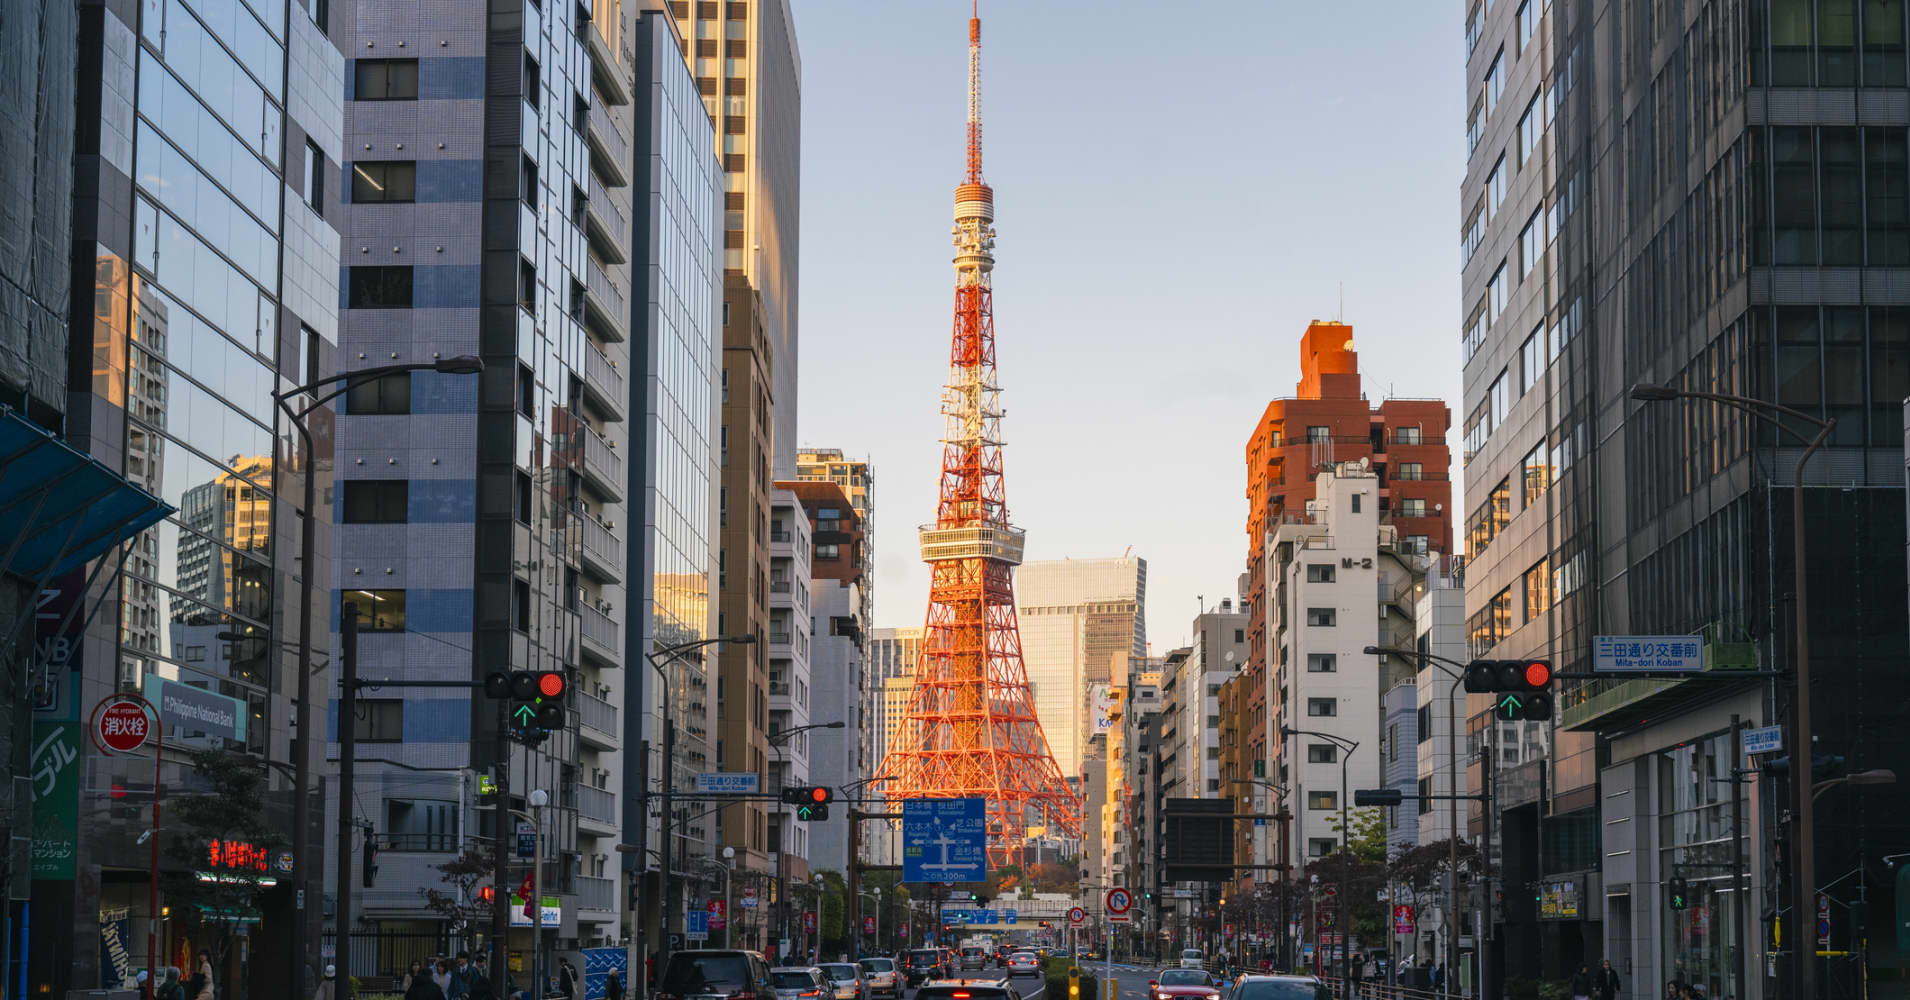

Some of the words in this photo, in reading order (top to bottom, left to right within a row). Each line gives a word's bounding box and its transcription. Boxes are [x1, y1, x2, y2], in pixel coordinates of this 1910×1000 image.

[1341, 557, 1373, 570] M-2
[34, 636, 70, 664] NB
[1599, 643, 1697, 658] 三田通り交番前
[1615, 658, 1654, 668] Mita-dori
[1656, 658, 1683, 668] Koban
[169, 696, 197, 720] Philippine
[197, 704, 220, 724] National
[220, 710, 234, 728] Bank
[104, 717, 145, 736] 消火栓
[905, 822, 933, 831] 六本木
[956, 818, 983, 827] 芝公園
[32, 849, 72, 858] マンション
[209, 838, 268, 872] まいばすけっと
